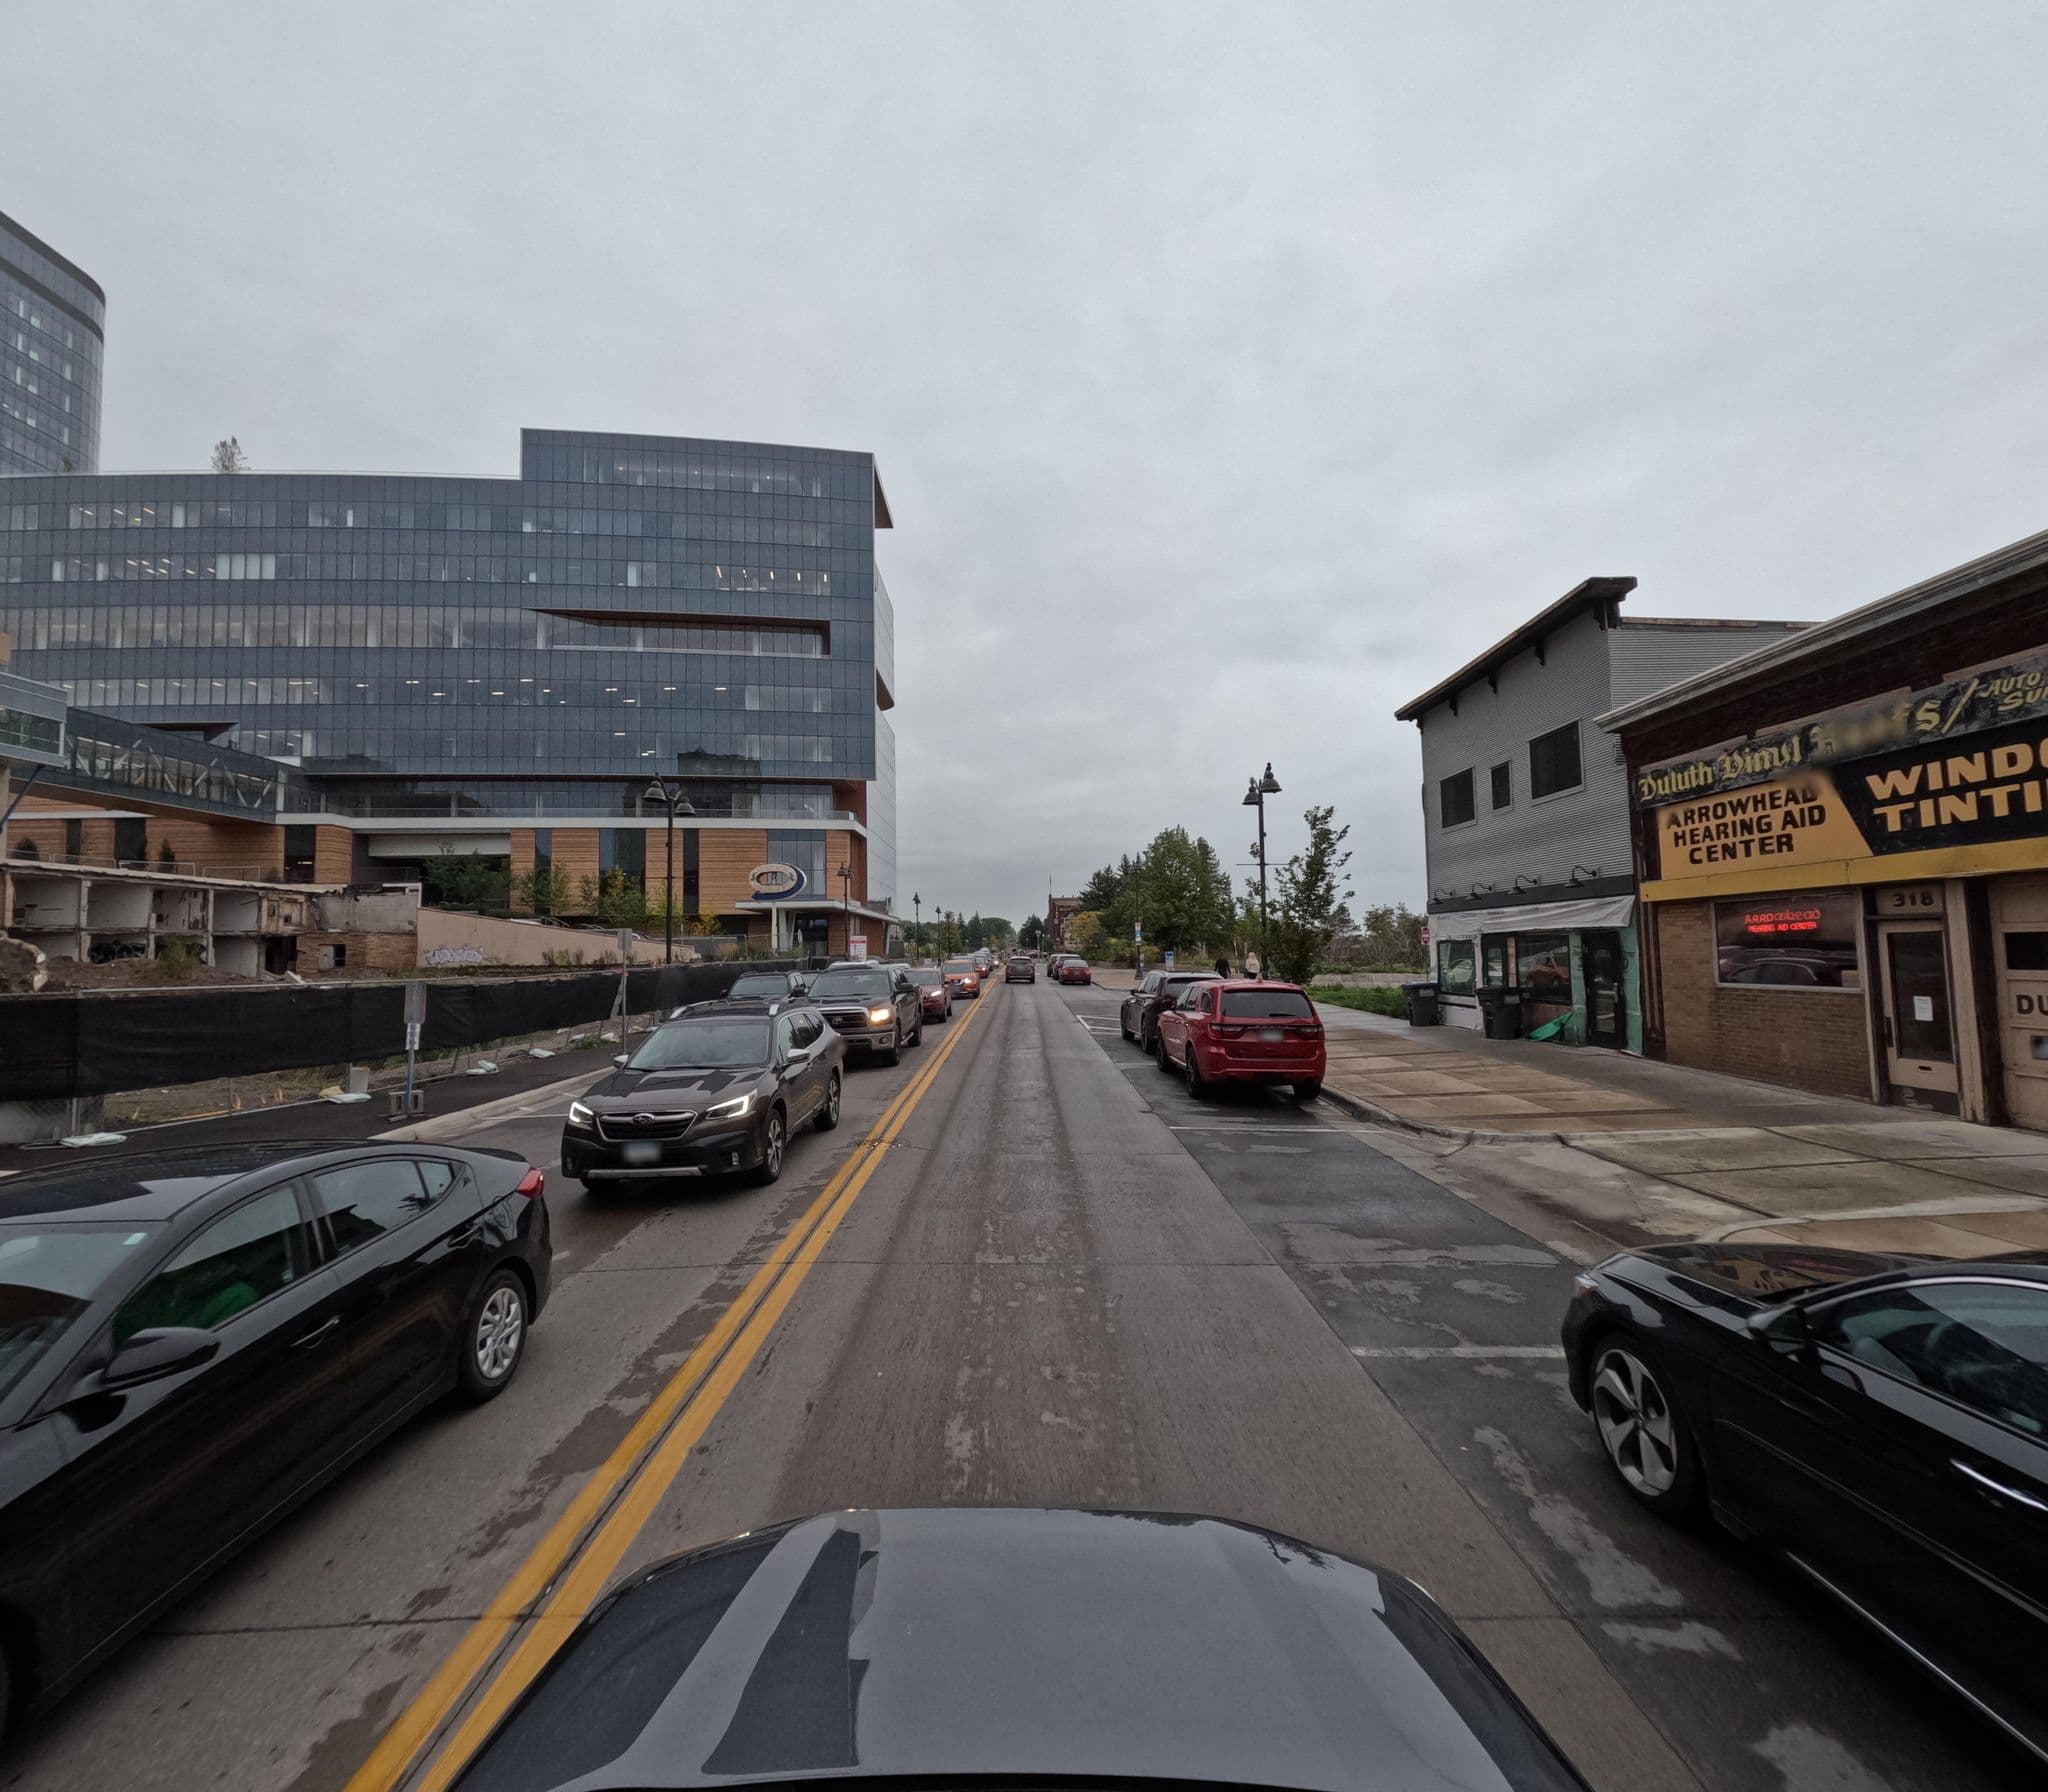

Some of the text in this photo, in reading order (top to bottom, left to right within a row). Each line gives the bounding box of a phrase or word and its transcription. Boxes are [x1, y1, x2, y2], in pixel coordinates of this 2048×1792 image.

[1638, 735, 1803, 802] Duluth Vinyl
[1865, 737, 2048, 800] WIND
[1667, 786, 1819, 830] ARROWHEAD
[1674, 804, 1827, 848] HEARING AID
[1873, 779, 2048, 833] TINTI
[1688, 833, 1795, 865] CENTER
